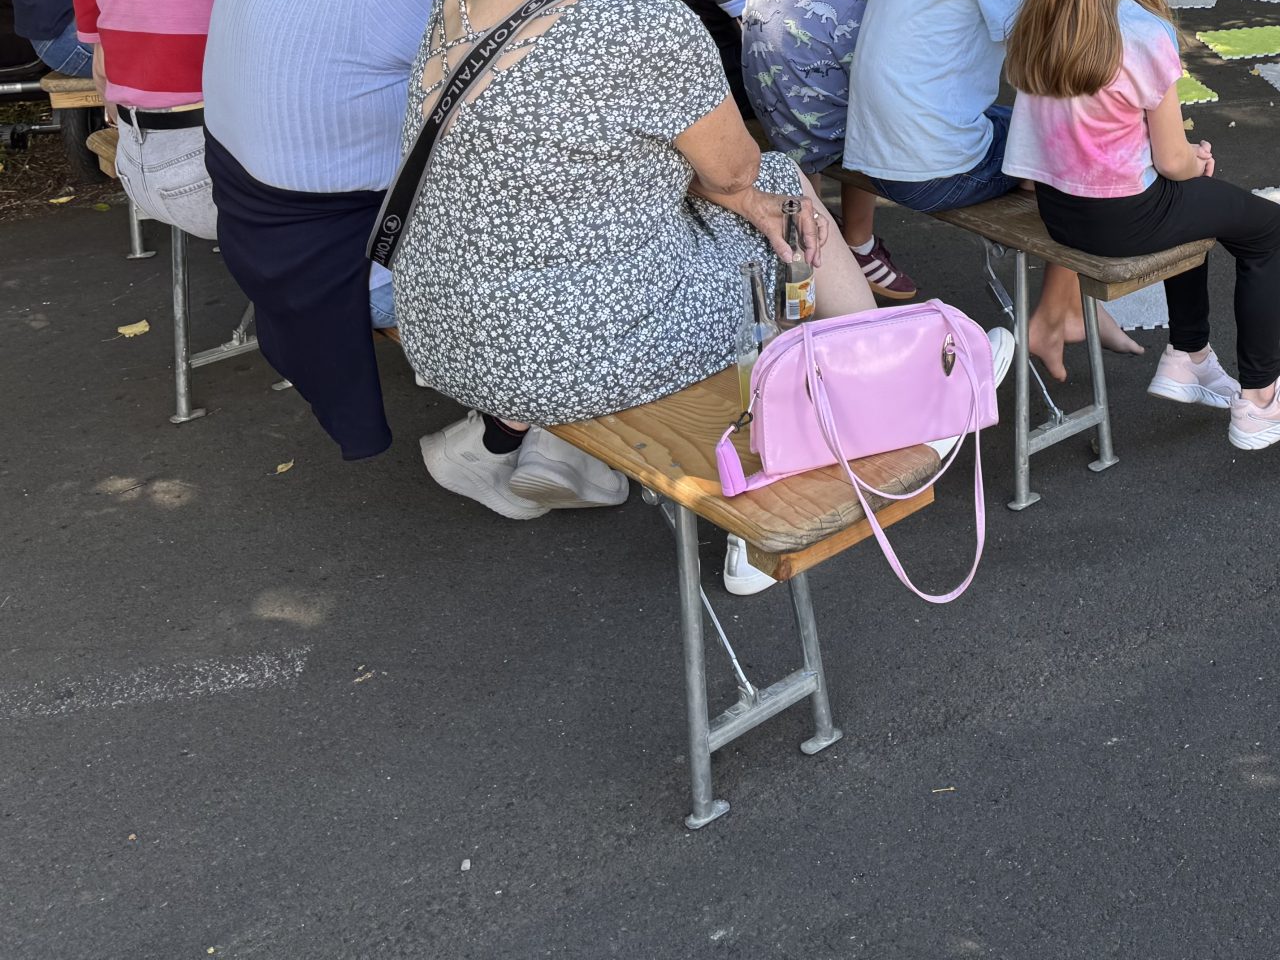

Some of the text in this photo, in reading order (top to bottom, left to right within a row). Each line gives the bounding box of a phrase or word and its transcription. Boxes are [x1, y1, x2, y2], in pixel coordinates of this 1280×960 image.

[433, 19, 522, 124] TOM TAILOR
[375, 235, 395, 259] TOM
